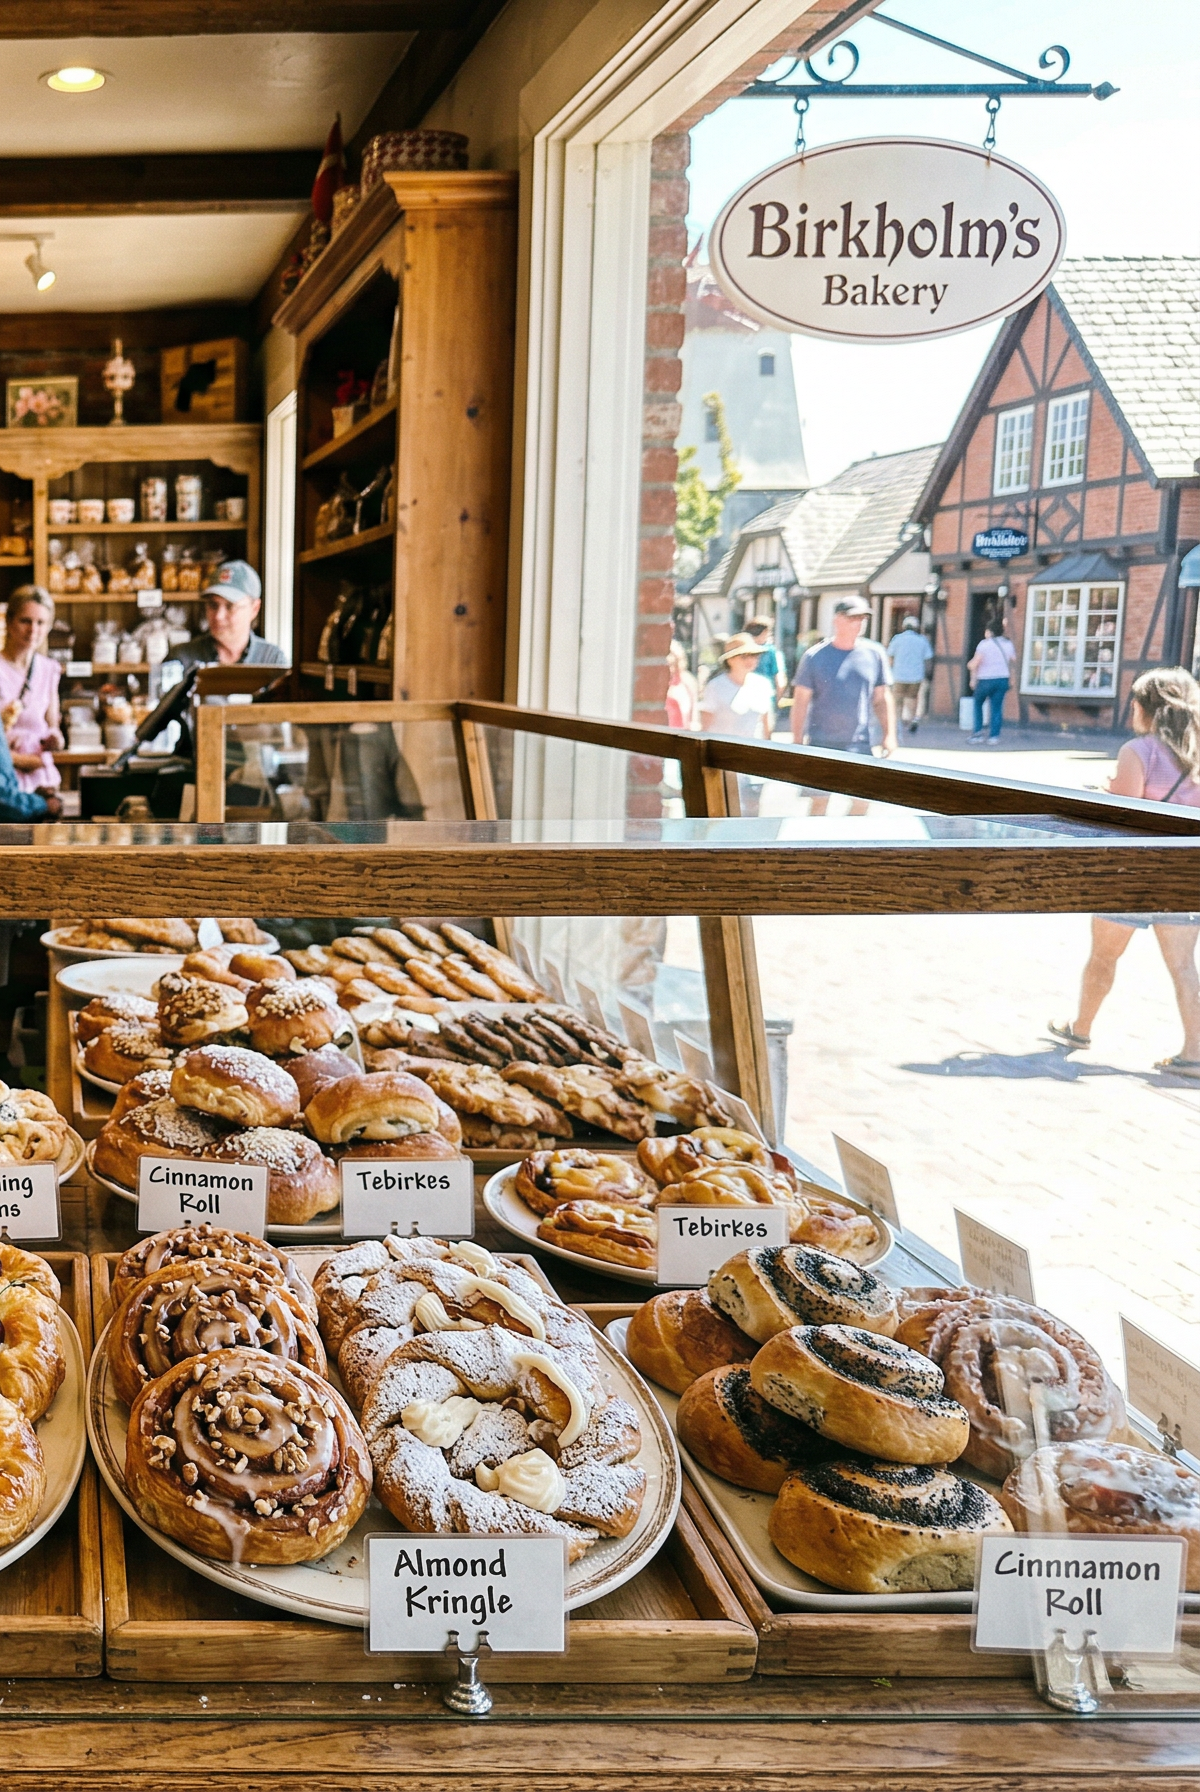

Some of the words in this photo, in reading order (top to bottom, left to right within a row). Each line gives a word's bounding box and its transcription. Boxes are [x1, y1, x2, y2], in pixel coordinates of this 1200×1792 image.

[748, 201, 1040, 267] Birkholm's
[823, 274, 949, 314] Bakery
[149, 1164, 254, 1191] Cinnamon
[356, 1170, 451, 1191] Tebirkes
[179, 1192, 220, 1215] Roll
[672, 1215, 768, 1238] Tebirkes
[394, 1548, 507, 1578] Almond
[994, 1550, 1160, 1581] Cinnnamon
[406, 1585, 513, 1625] Kringle
[1045, 1587, 1102, 1616] Roll
